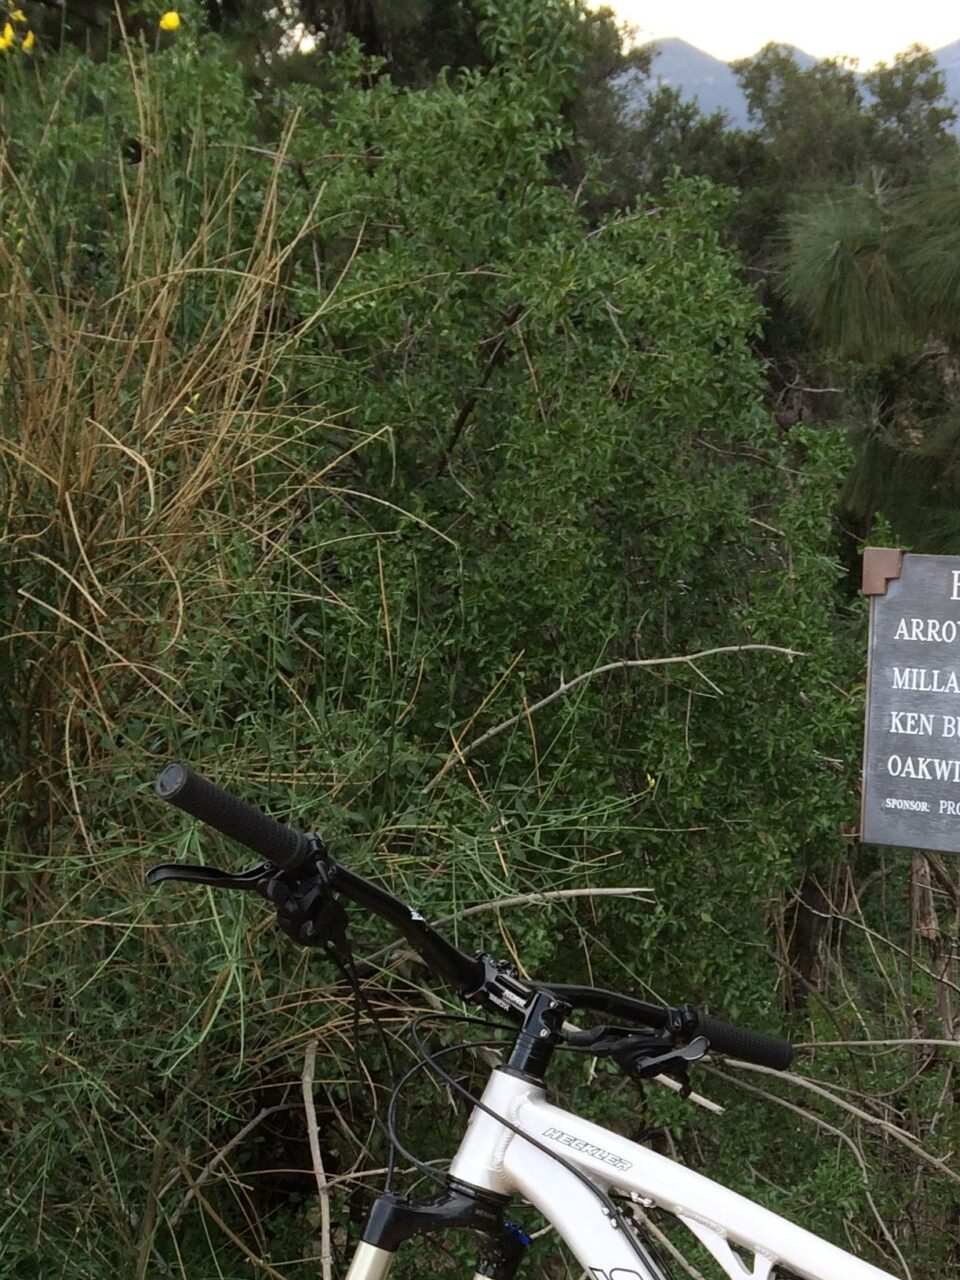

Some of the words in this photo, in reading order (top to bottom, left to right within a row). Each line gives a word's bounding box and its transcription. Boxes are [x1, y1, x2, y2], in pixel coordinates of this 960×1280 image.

[890, 711, 935, 736] KEN
[885, 798, 930, 812] SPONSOR:
[542, 1127, 633, 1172] HECKLER
